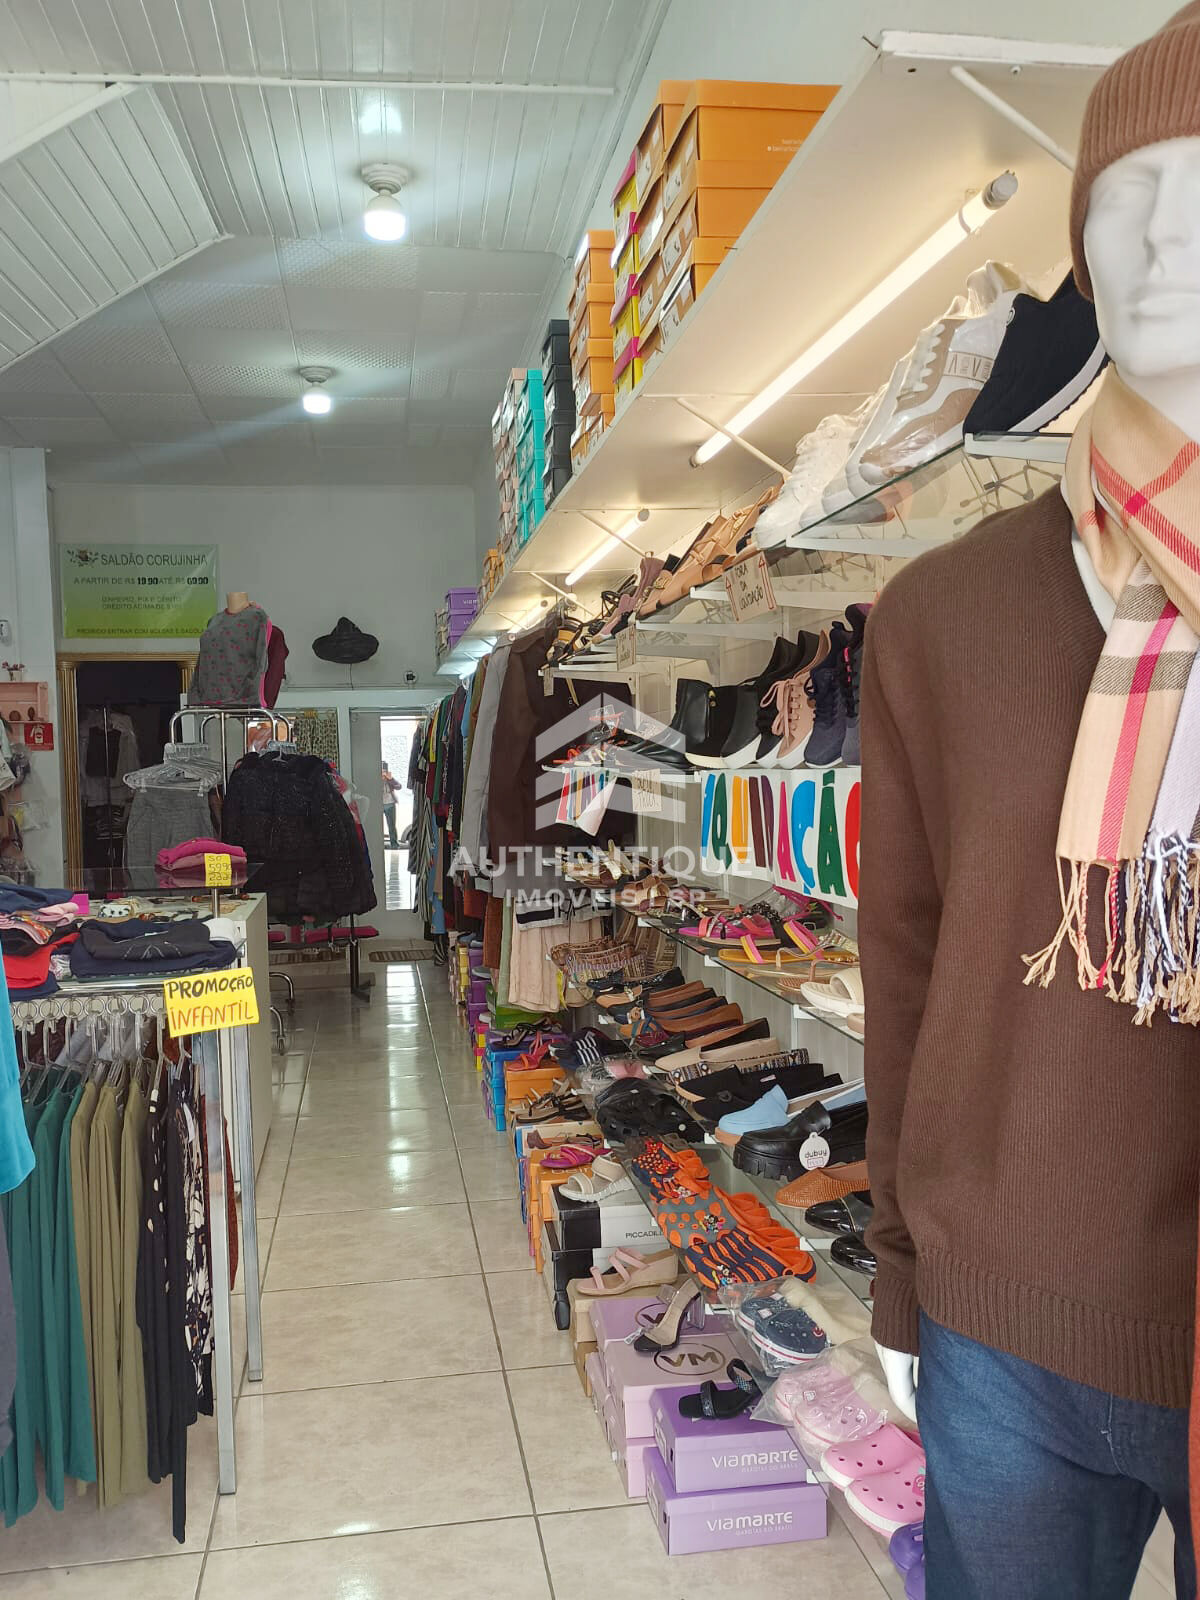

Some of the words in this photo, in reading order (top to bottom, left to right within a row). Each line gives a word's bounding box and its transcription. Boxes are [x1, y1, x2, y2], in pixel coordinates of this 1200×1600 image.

[101, 552, 143, 566] SALDÃO
[146, 553, 207, 566] CORUJINHA
[81, 576, 109, 585] PARTIR
[111, 576, 123, 585] DE
[165, 974, 253, 999] PROMOÇÃO
[169, 1000, 254, 1031] INFANTIL
[625, 1230, 664, 1239] PICCADILL
[659, 1351, 720, 1368] VM
